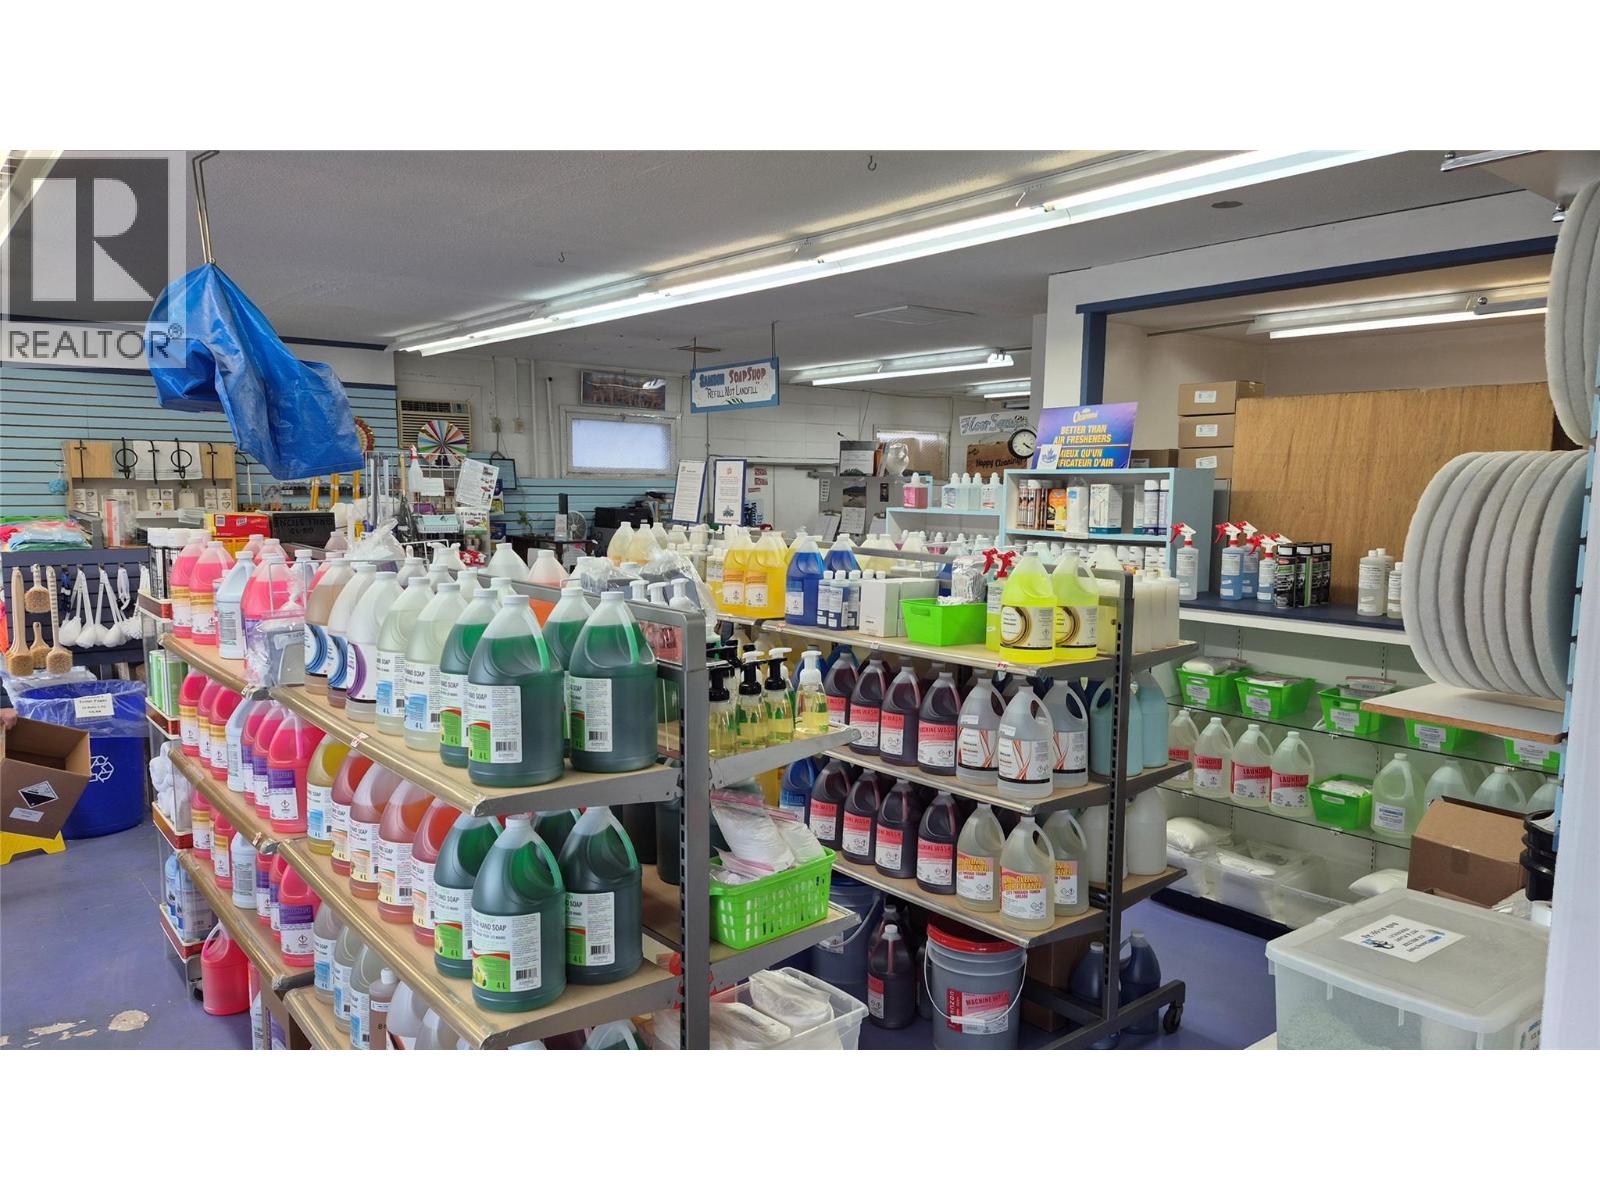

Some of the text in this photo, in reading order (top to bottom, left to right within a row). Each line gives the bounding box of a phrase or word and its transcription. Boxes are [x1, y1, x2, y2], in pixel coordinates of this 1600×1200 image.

[1060, 424, 1108, 435] BETTER THAN
[1066, 433, 1112, 445] FRESHENERS
